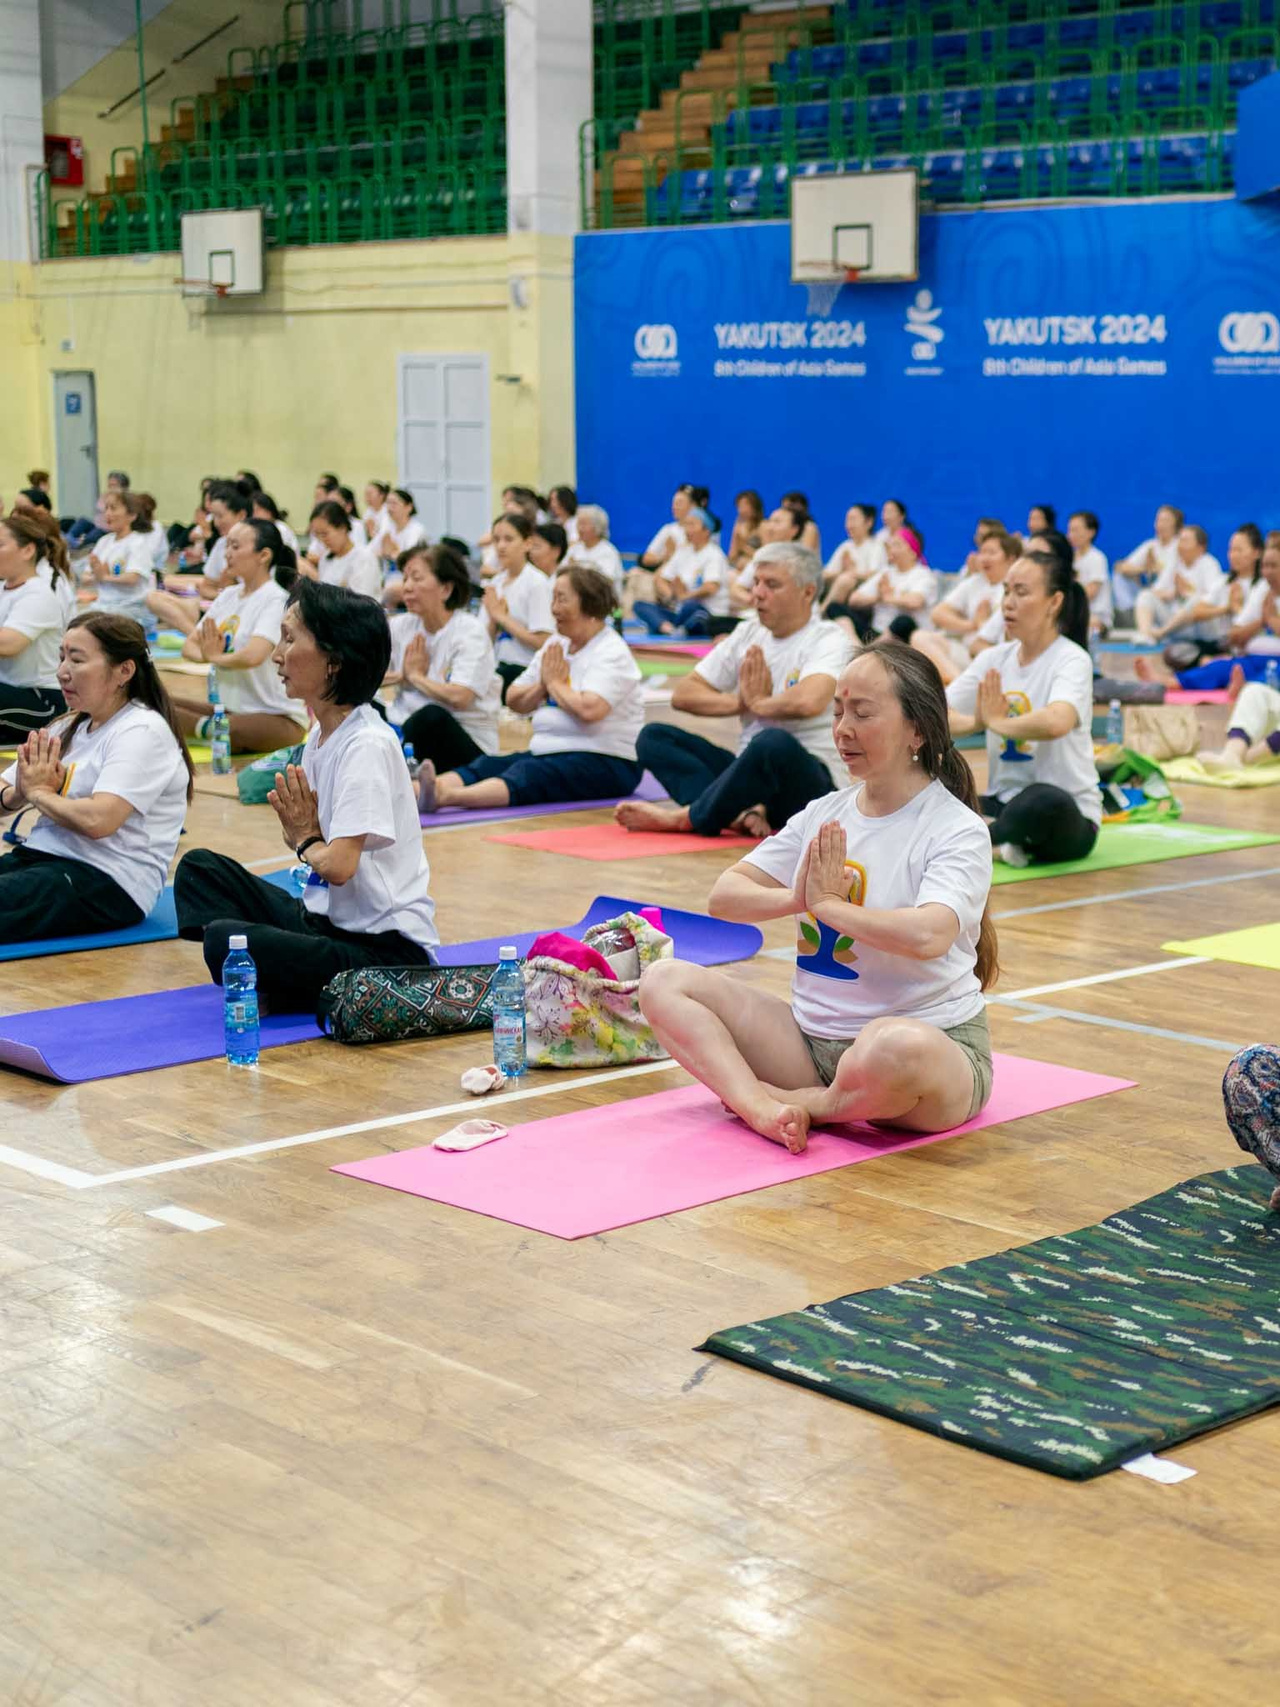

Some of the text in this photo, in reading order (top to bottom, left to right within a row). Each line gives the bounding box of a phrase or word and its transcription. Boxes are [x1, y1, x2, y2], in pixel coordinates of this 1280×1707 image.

[713, 320, 867, 350] YAKUTSK 2024
[983, 314, 1168, 346] YAKUTSK 2024
[713, 358, 867, 378] 8th Children of Asia Games
[982, 355, 1167, 377] 8th Children of Asia Games
